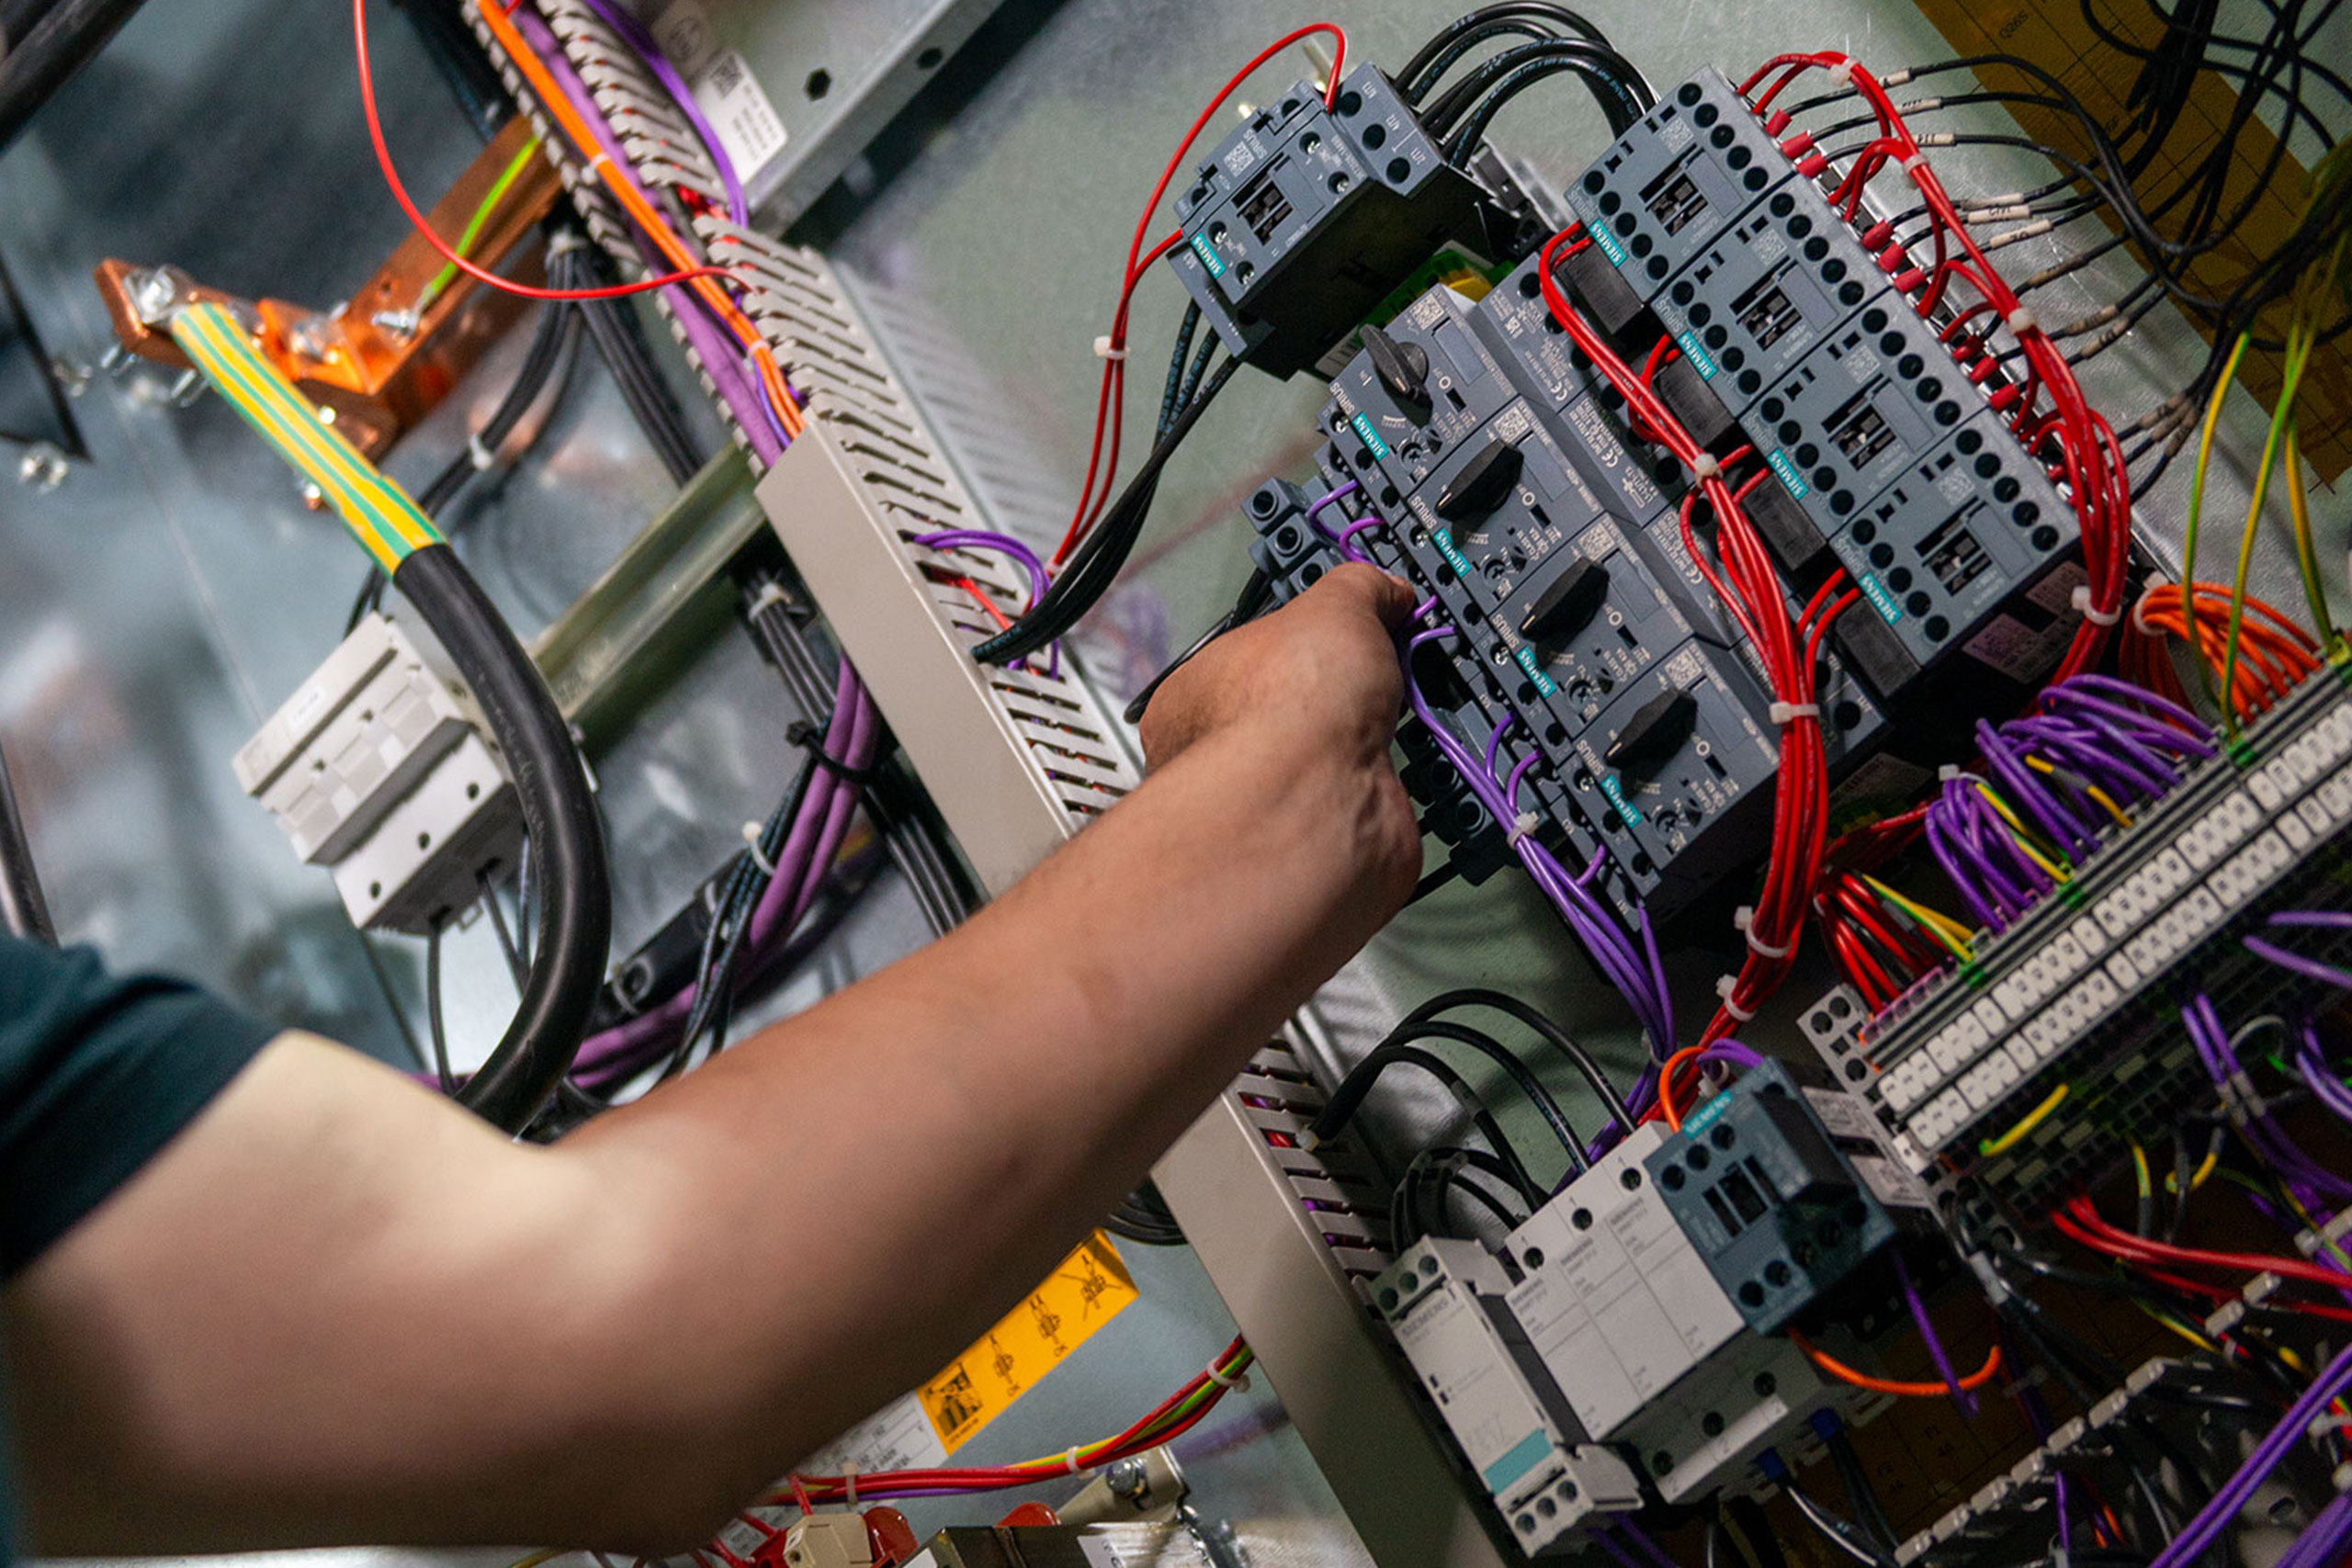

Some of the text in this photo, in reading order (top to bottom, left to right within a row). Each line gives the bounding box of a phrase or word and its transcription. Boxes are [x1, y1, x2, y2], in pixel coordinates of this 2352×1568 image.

[1242, 128, 1268, 158] SIRIUS
[1567, 189, 1622, 262] SIEMENS SIRIUS
[1191, 236, 1222, 274] SIEMENS
[1656, 299, 1713, 375] SIEMENS SIRIUS
[1329, 381, 1385, 456] SIEMENS SIRIUS
[1769, 453, 1804, 494] SIEMENS
[1410, 495, 1437, 528] SIRIUS
[1435, 531, 1466, 571] SIEMENS
[1520, 536, 1535, 555] CLASS
[1860, 576, 1897, 620] SIEMENS
[1492, 613, 1520, 647] SIRIUS
[1518, 649, 1552, 693] SIEMENS
[1607, 657, 1623, 676] CLASS
[1576, 739, 1605, 775] SIRIUS
[1603, 778, 1637, 822] SIEMENS
[1053, 1343, 1068, 1357] OK
[1006, 1382, 1021, 1396] OK
